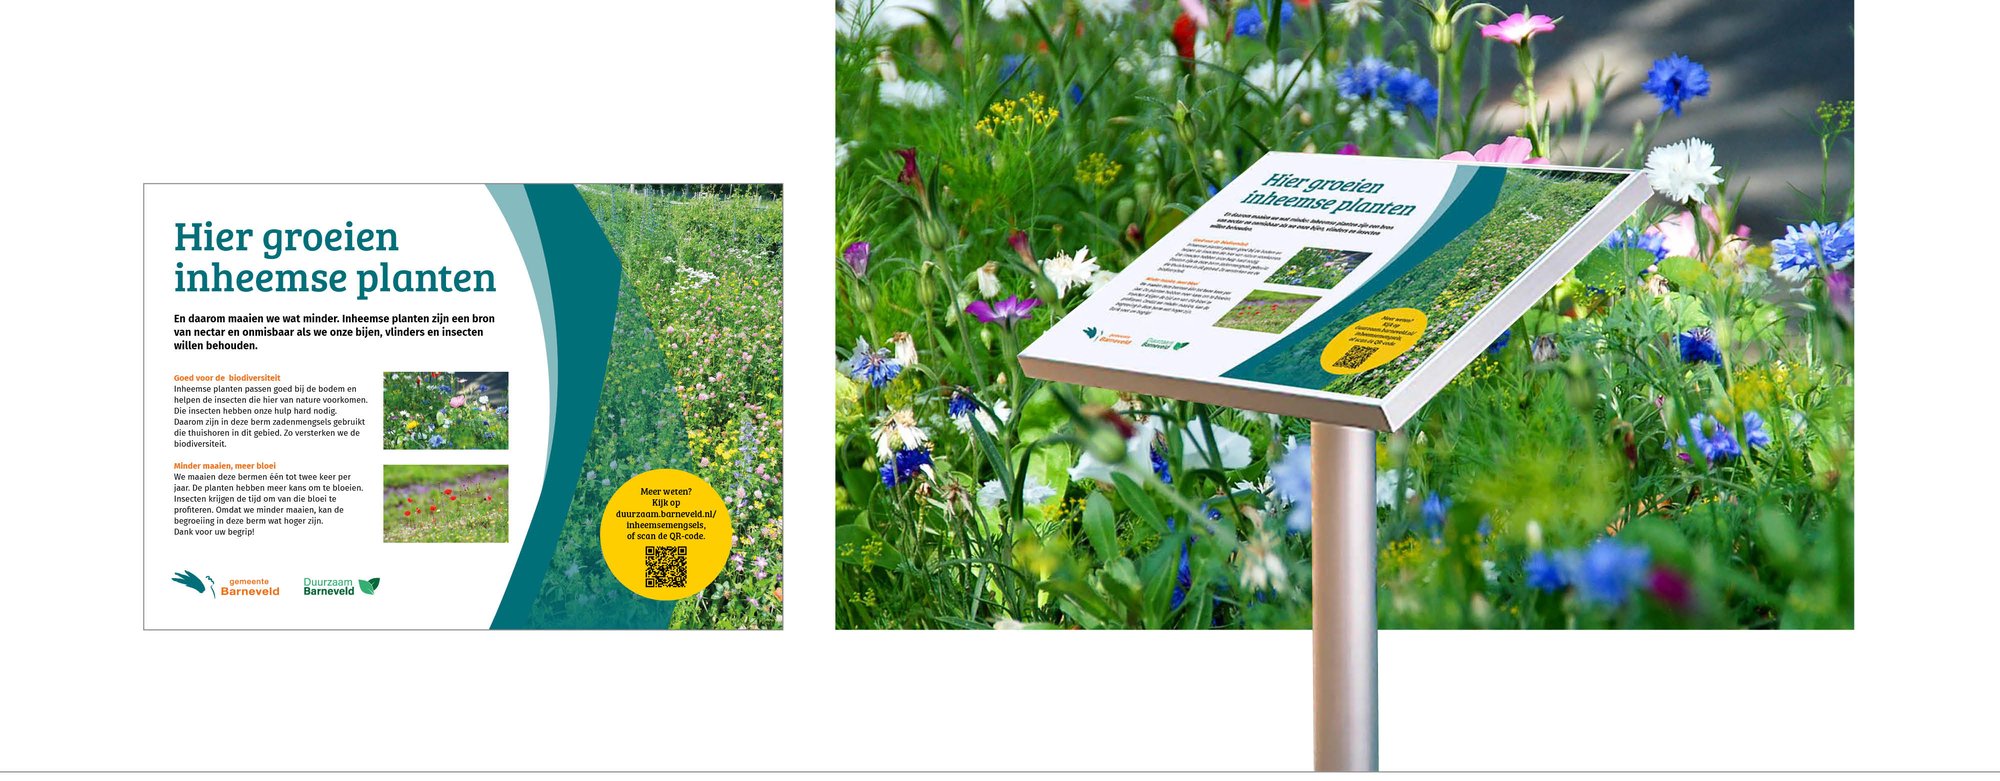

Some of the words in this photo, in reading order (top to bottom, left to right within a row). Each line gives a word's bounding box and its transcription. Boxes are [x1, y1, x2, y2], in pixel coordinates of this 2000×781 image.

[1261, 173, 1310, 189] Hier
[1302, 178, 1385, 194] groeien
[1240, 190, 1338, 210] inheemse
[1329, 198, 1417, 216] planten
[175, 221, 253, 251] Hier
[263, 221, 399, 259] groeien
[175, 262, 346, 292] inheemse
[357, 262, 496, 300] planten
[174, 314, 185, 323] En
[188, 314, 225, 323] daarom
[228, 313, 263, 323] maaien
[283, 315, 300, 323] wat
[303, 313, 339, 323] minder.
[342, 314, 389, 323] Inheemse
[392, 314, 429, 324] planten
[432, 313, 449, 324] zijn
[473, 314, 495, 323] bron
[194, 328, 225, 336] nectar
[242, 327, 294, 336] onmisbaar
[297, 327, 311, 336] als
[356, 327, 382, 338] bijen,
[385, 327, 425, 336] vlinders
[442, 327, 483, 336] insecten
[174, 340, 203, 350] willen
[206, 341, 257, 350] behouden.
[214, 385, 242, 394] planten
[274, 385, 292, 394] goed
[295, 385, 304, 393] bij
[174, 396, 200, 404] helpen
[275, 407, 291, 416] hulp
[314, 407, 337, 416] nodig.
[206, 418, 218, 426] zijn
[273, 418, 331, 427] zadenmengsels
[334, 418, 365, 427] gebruikt
[254, 429, 281, 438] gebied.
[203, 462, 232, 470] maaien,
[174, 484, 190, 493] jaar.
[205, 484, 233, 493] planten
[209, 495, 234, 504] krijgen
[248, 495, 261, 503] tijd
[652, 499, 668, 508] Kijk
[174, 506, 213, 515] profiteren.
[286, 506, 316, 514] maaien,
[616, 510, 716, 518] duurzaam.barneveld.nl/
[174, 517, 214, 526] begroeiing
[284, 517, 305, 526] hoger
[308, 517, 323, 525] zijn.
[627, 522, 707, 530] inheemsemengsels,
[228, 528, 254, 537] begrip!
[670, 532, 705, 541] QR-code.
[229, 578, 269, 586] gemeente
[304, 578, 352, 586] Duurzaam
[221, 587, 280, 595] Barneveld
[304, 586, 354, 595] Barneveld
